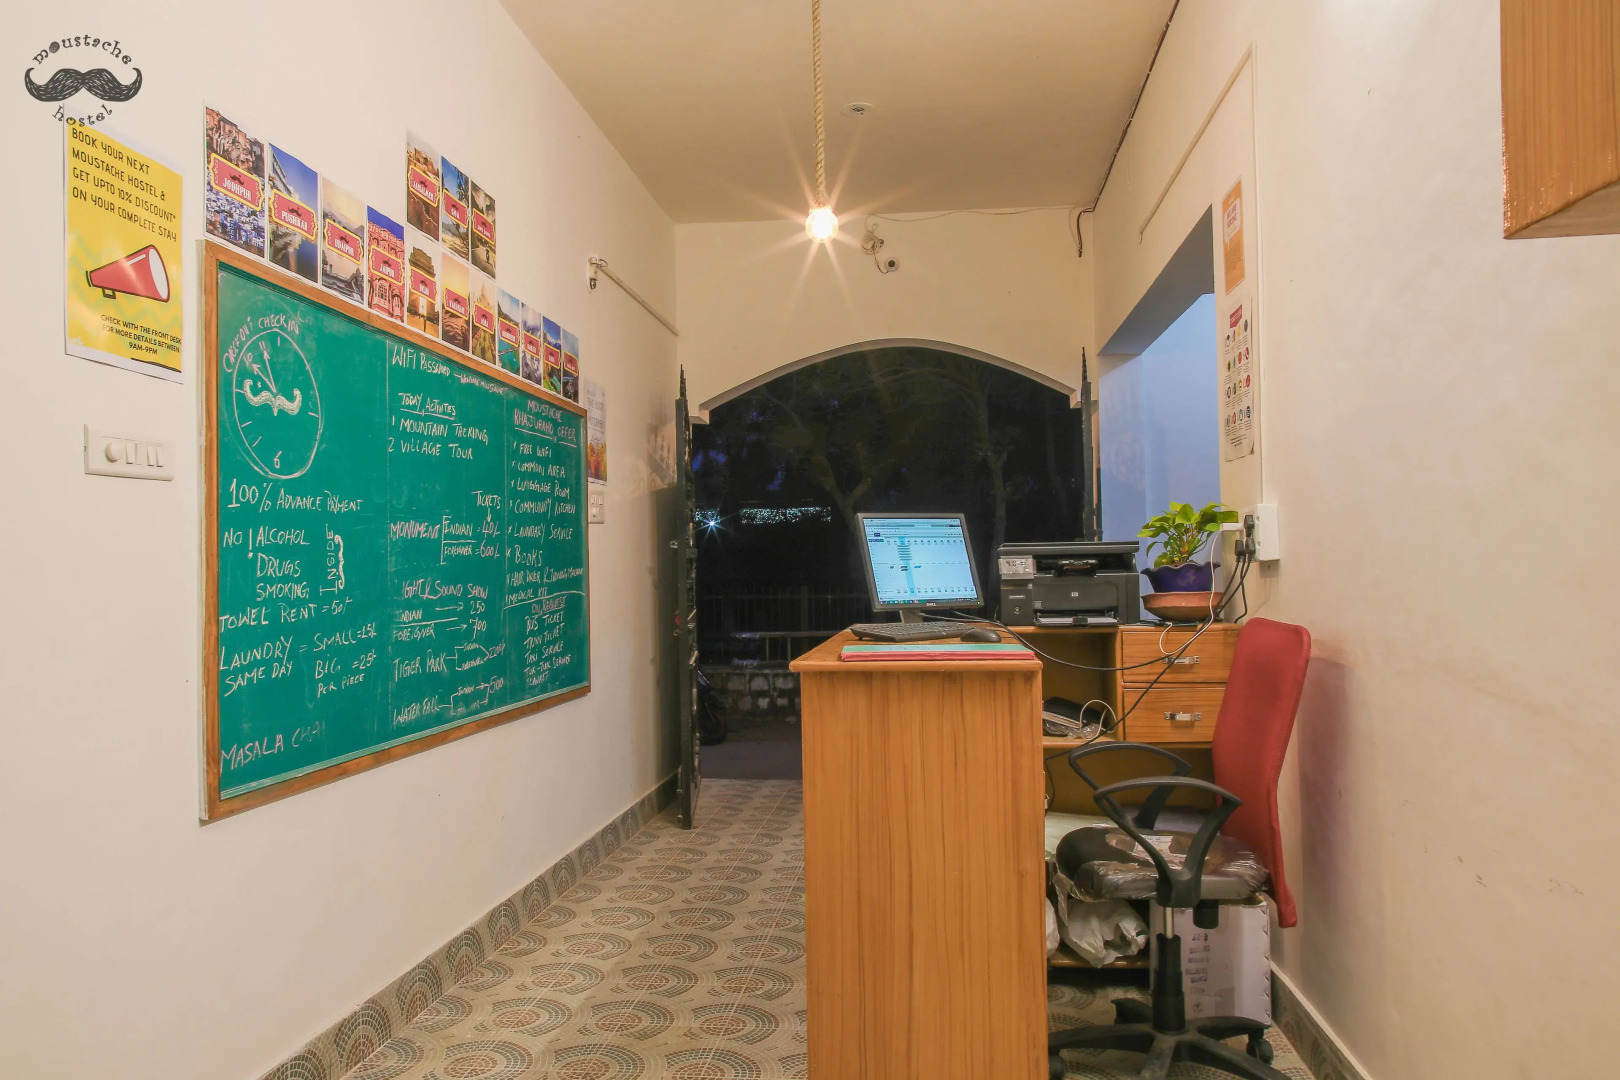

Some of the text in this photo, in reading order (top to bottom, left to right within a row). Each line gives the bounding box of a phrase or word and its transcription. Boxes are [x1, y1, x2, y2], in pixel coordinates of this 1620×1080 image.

[72, 127, 150, 175] BOOK YOUR NEXT
[72, 147, 166, 201] MOUSTACHE HOSTEL &
[73, 166, 90, 183] GET
[93, 175, 115, 195] UPTO
[118, 187, 132, 204] 10%
[222, 178, 252, 201] JODHPUR
[72, 186, 177, 243] ON YOUR COMPLETE STAY
[281, 210, 308, 232] PUSHKAR
[101, 314, 182, 345] CHECK WITH THE FRONT DESK
[102, 324, 180, 353] FOR MORE DETAILS BETWEEN
[128, 341, 158, 355] 9AM-9PM
[527, 399, 563, 423] MOUSTACHE
[399, 418, 448, 438] MOUNTAIN
[557, 425, 577, 443] OFFER
[274, 450, 282, 468] 6
[388, 437, 395, 452] 2
[448, 443, 473, 460] TOUR
[519, 443, 533, 454] FREE
[517, 460, 566, 478] COMMON AREA
[227, 478, 364, 514] 100% ADVANCE PAYMENT
[471, 490, 501, 509] TICKETS
[223, 528, 242, 548] NO
[256, 526, 310, 547] ALCOHOL
[390, 520, 440, 540] MONUMENT
[548, 523, 573, 540] SERVICE
[256, 552, 301, 578] DRUGS
[319, 524, 338, 597] INSIDE
[514, 544, 543, 568] BOOKS
[434, 580, 463, 599] SOUND
[467, 583, 489, 599] SHOW
[219, 605, 271, 633] TOWEL
[277, 602, 317, 623] RENT
[470, 600, 486, 615] 250
[542, 611, 564, 627] TICKET
[469, 617, 487, 641] 700
[543, 622, 565, 643] TICKET
[219, 635, 293, 671] LAUNDRY
[313, 629, 356, 652] SMALL
[393, 648, 447, 682] TIGER PARK
[224, 660, 293, 698] SAME DAY
[489, 675, 504, 694] 500
[393, 702, 420, 730] WATER
[219, 733, 284, 778] MASALA
